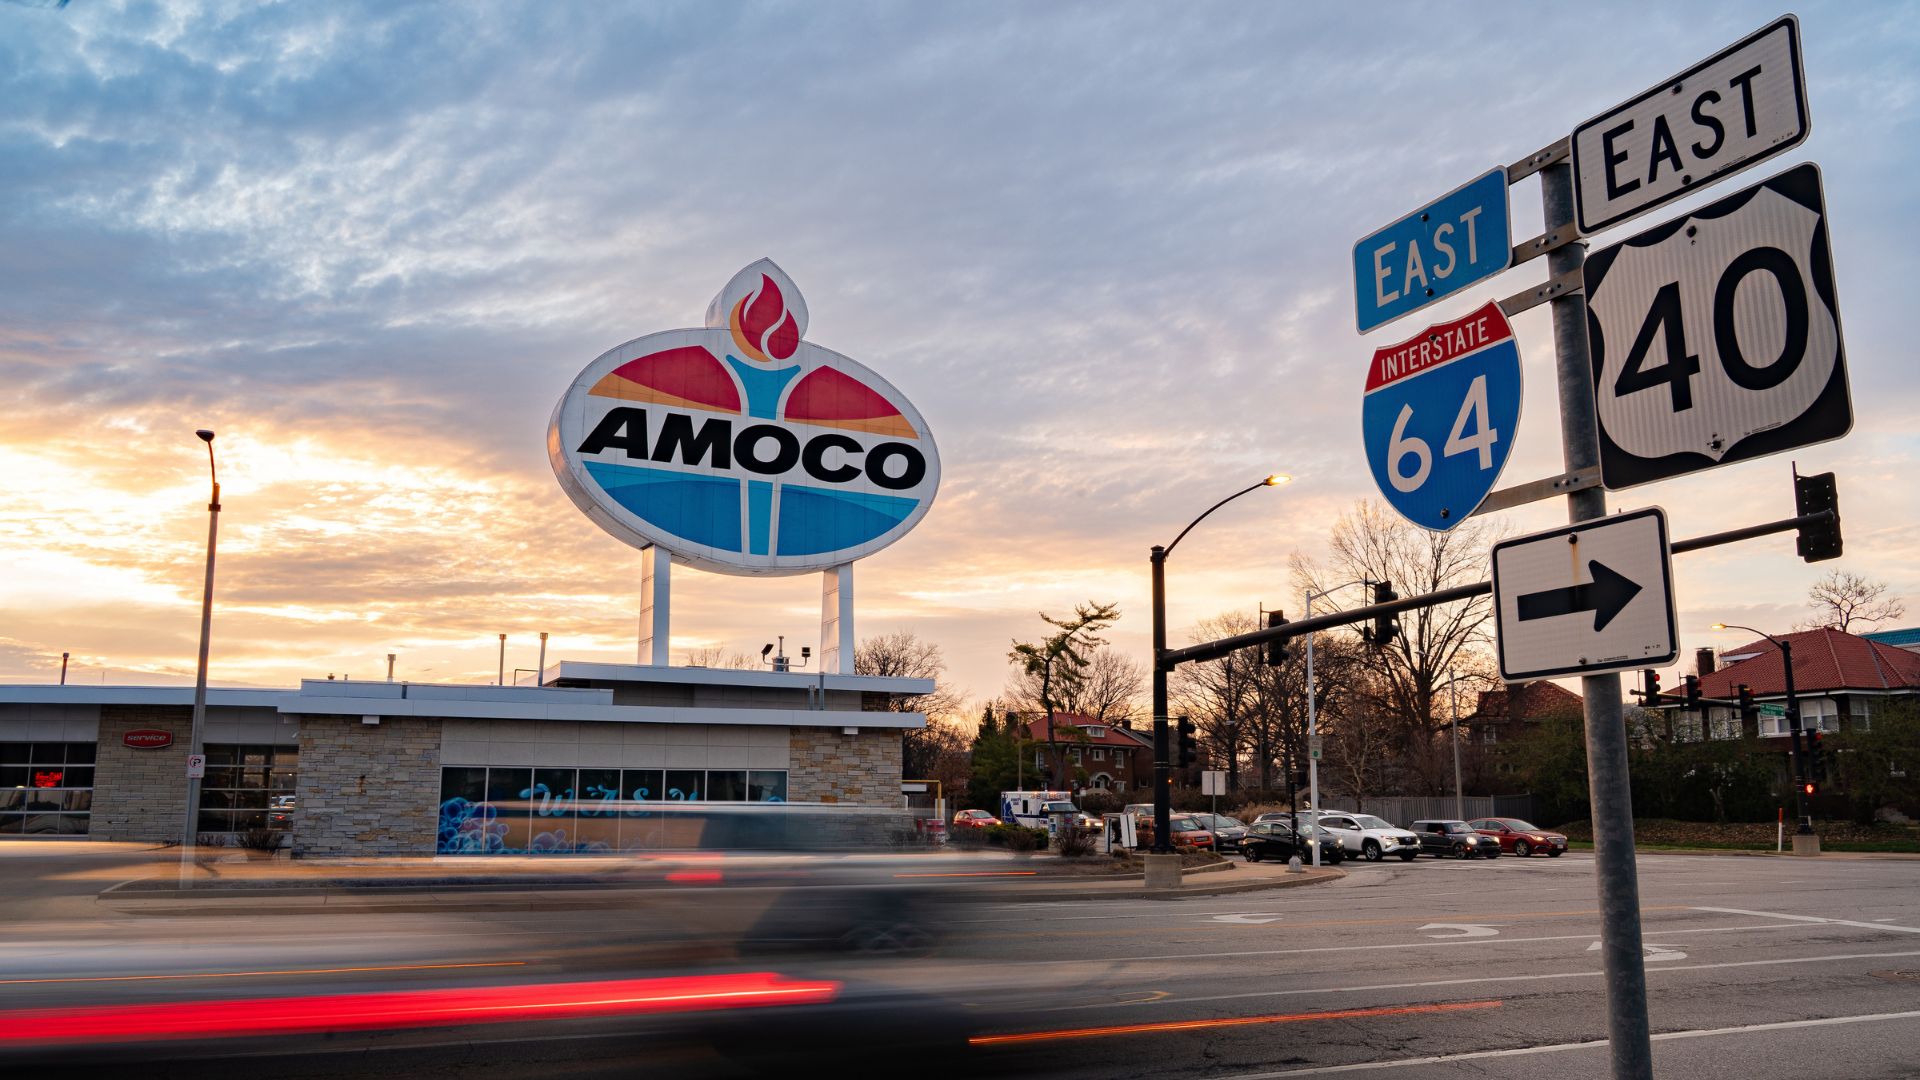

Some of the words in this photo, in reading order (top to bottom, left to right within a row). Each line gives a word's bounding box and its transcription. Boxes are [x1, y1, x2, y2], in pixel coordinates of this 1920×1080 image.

[1602, 64, 1762, 201] EAST
[1374, 205, 1483, 308] EAST
[1381, 315, 1490, 381] INTERSTATE
[1614, 246, 1809, 413] 40
[576, 406, 927, 490] AMOCO
[1388, 374, 1498, 494] 64
